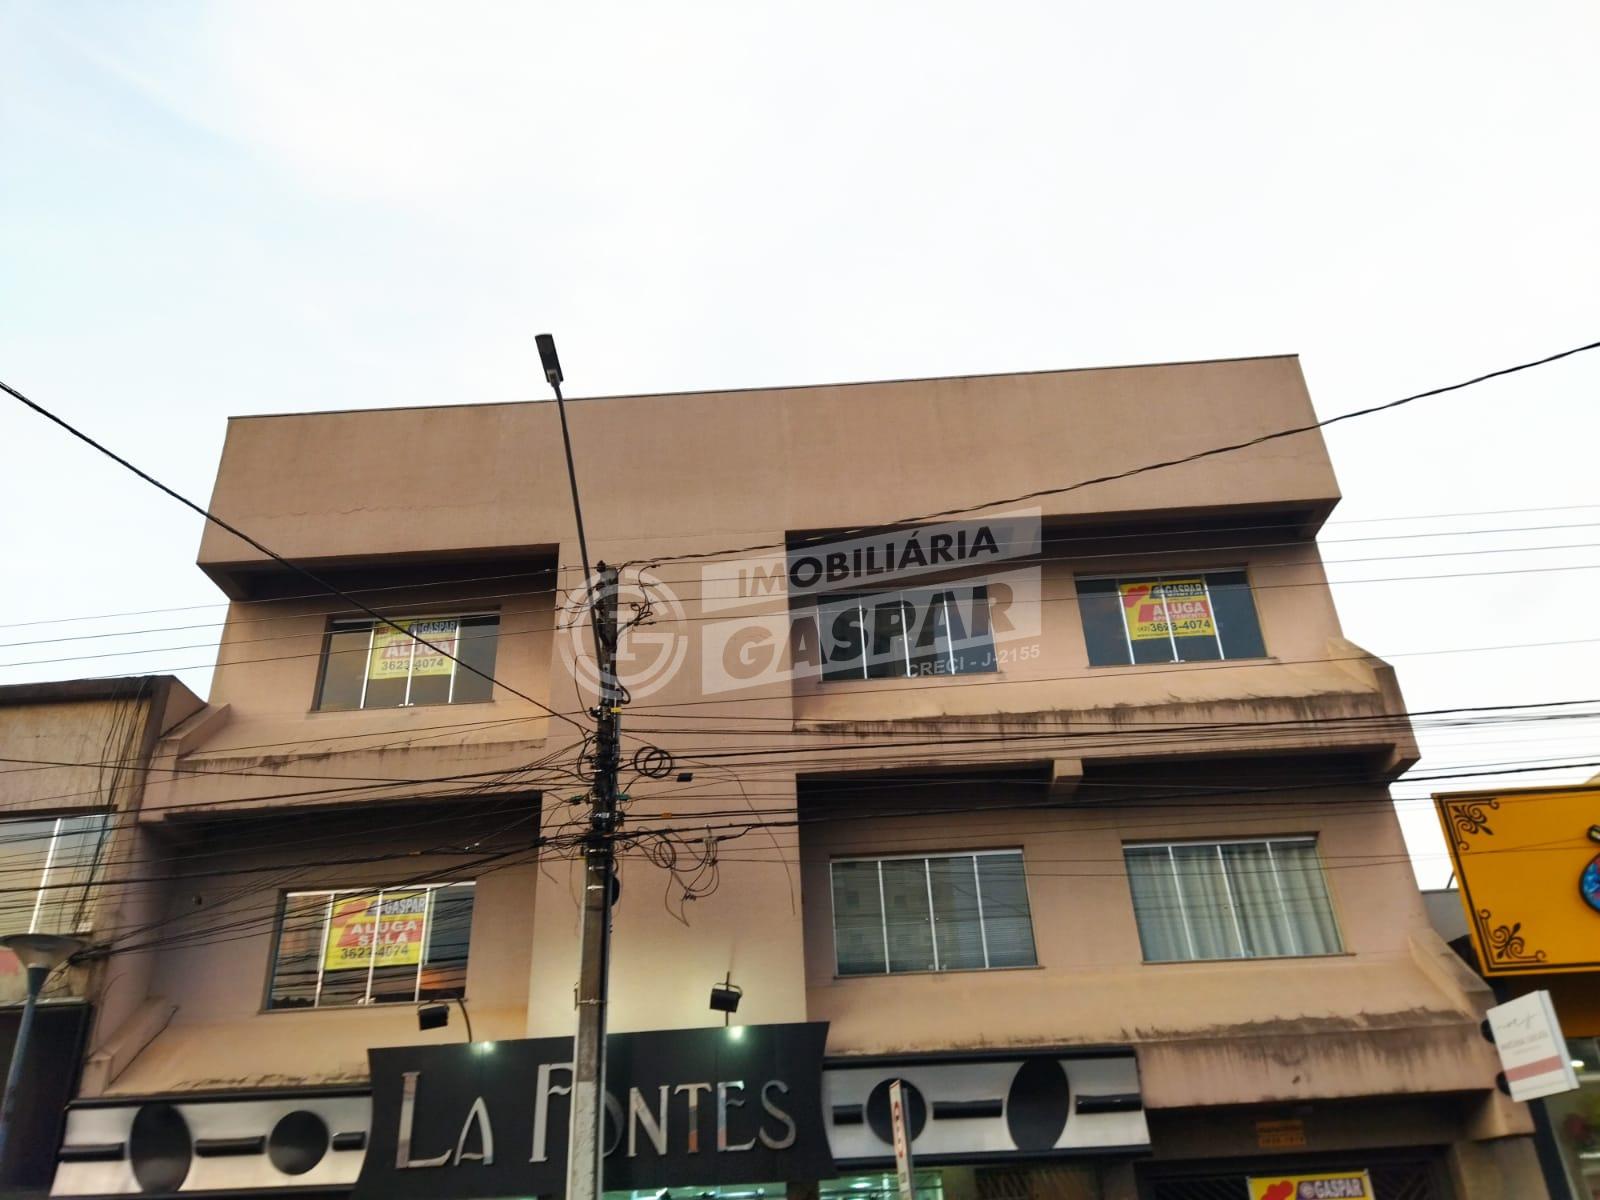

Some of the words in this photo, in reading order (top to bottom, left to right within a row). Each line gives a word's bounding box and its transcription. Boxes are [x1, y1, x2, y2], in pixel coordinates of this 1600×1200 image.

[1165, 584, 1204, 597] GASPAR
[1153, 602, 1205, 615] AUGA
[421, 621, 457, 634] GASPAR
[382, 658, 444, 671] 36234074
[385, 897, 426, 914] GASPAR
[351, 920, 417, 935] ALUGA
[395, 1070, 495, 1170] LA
[1314, 1177, 1363, 1199] GASPAR
